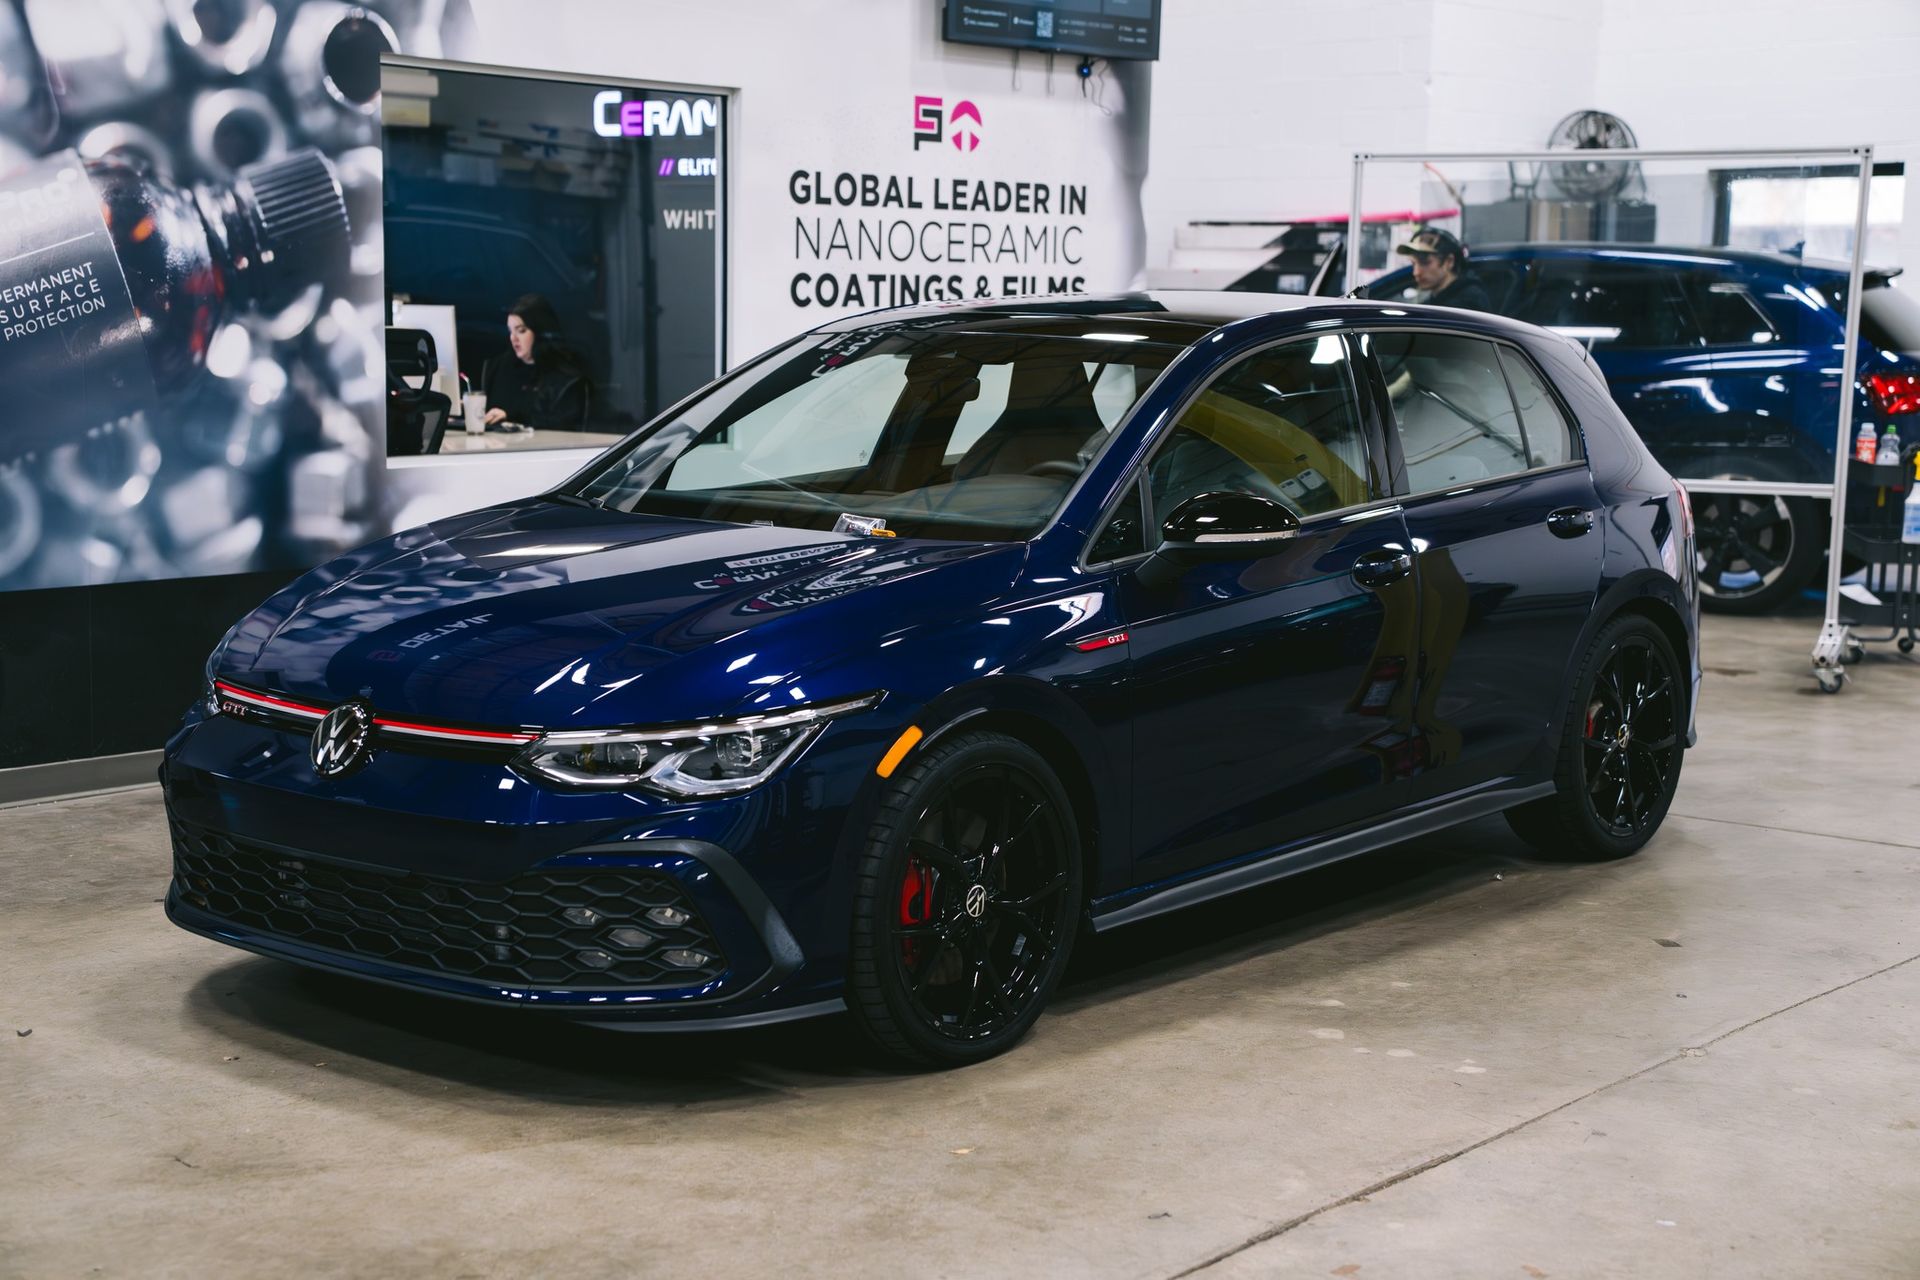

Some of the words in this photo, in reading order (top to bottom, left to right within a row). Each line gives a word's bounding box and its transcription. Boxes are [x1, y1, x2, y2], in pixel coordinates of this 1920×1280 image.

[789, 169, 923, 208] GLOBAL
[933, 178, 1050, 214] LEADER
[1060, 184, 1087, 215] IN
[794, 216, 1084, 265] NANOCERAMIC
[0, 261, 93, 304] ERMANENT
[0, 278, 101, 324] SURFACE
[790, 272, 964, 308] COATINGS
[974, 275, 992, 299] &
[3, 295, 106, 341] PROTECTION
[1107, 633, 1125, 644] GTI
[222, 700, 249, 716] GTI
